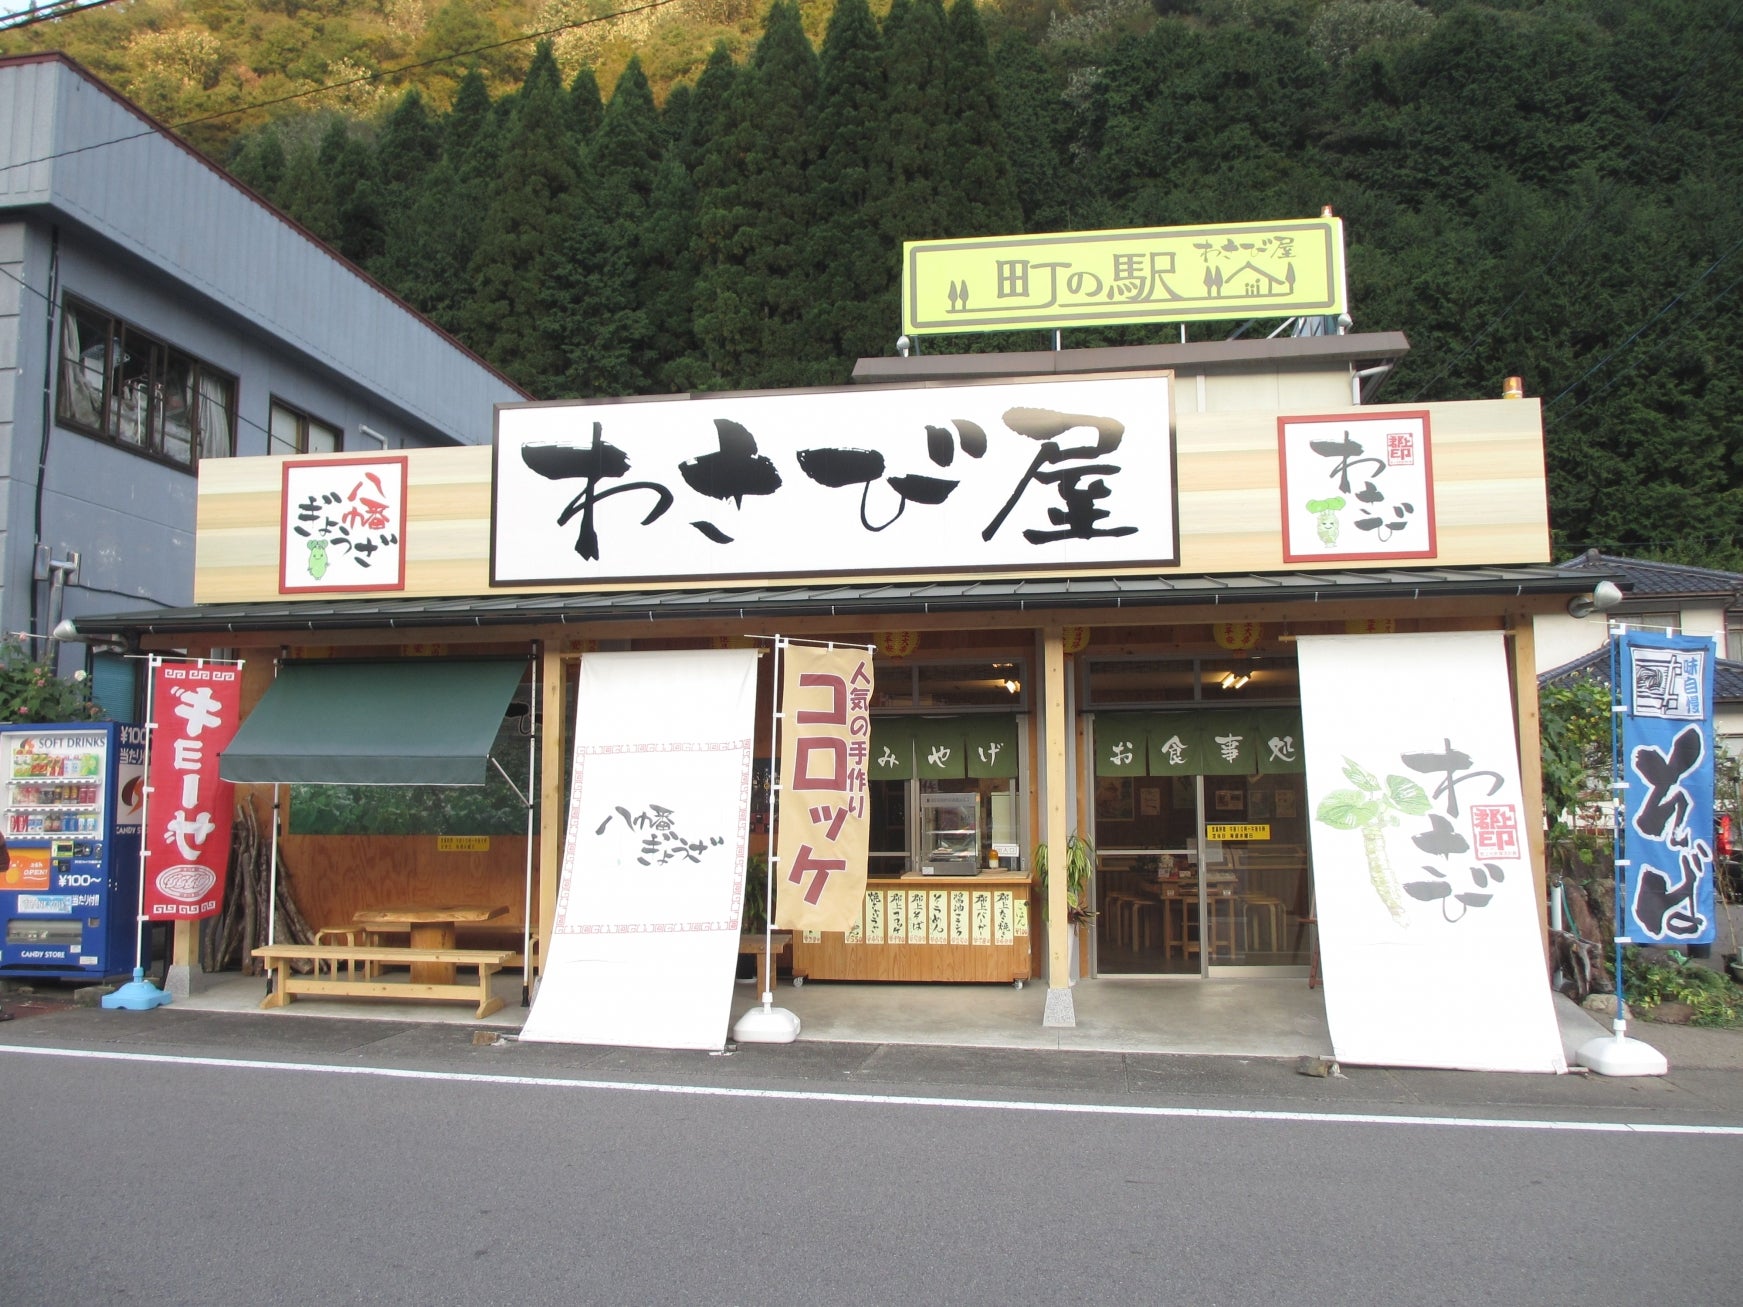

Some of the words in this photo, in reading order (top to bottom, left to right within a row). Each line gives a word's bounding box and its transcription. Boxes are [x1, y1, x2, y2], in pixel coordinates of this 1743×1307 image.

[996, 252, 1184, 308] 町の駅
[1193, 236, 1296, 263] わさび屋
[521, 406, 1138, 561] わさび屋
[1309, 430, 1414, 542] わさび
[293, 491, 398, 568] ぎょうざ
[1684, 657, 1700, 714] 味自慢
[39, 737, 64, 749] SOFT
[67, 736, 106, 748] DRINKS
[848, 661, 872, 819] 人気の手作り
[1110, 733, 1296, 765] お食事処
[788, 673, 848, 906] コロッケ
[637, 831, 724, 866] ぎょうざ
[1400, 738, 1505, 923] わさび
